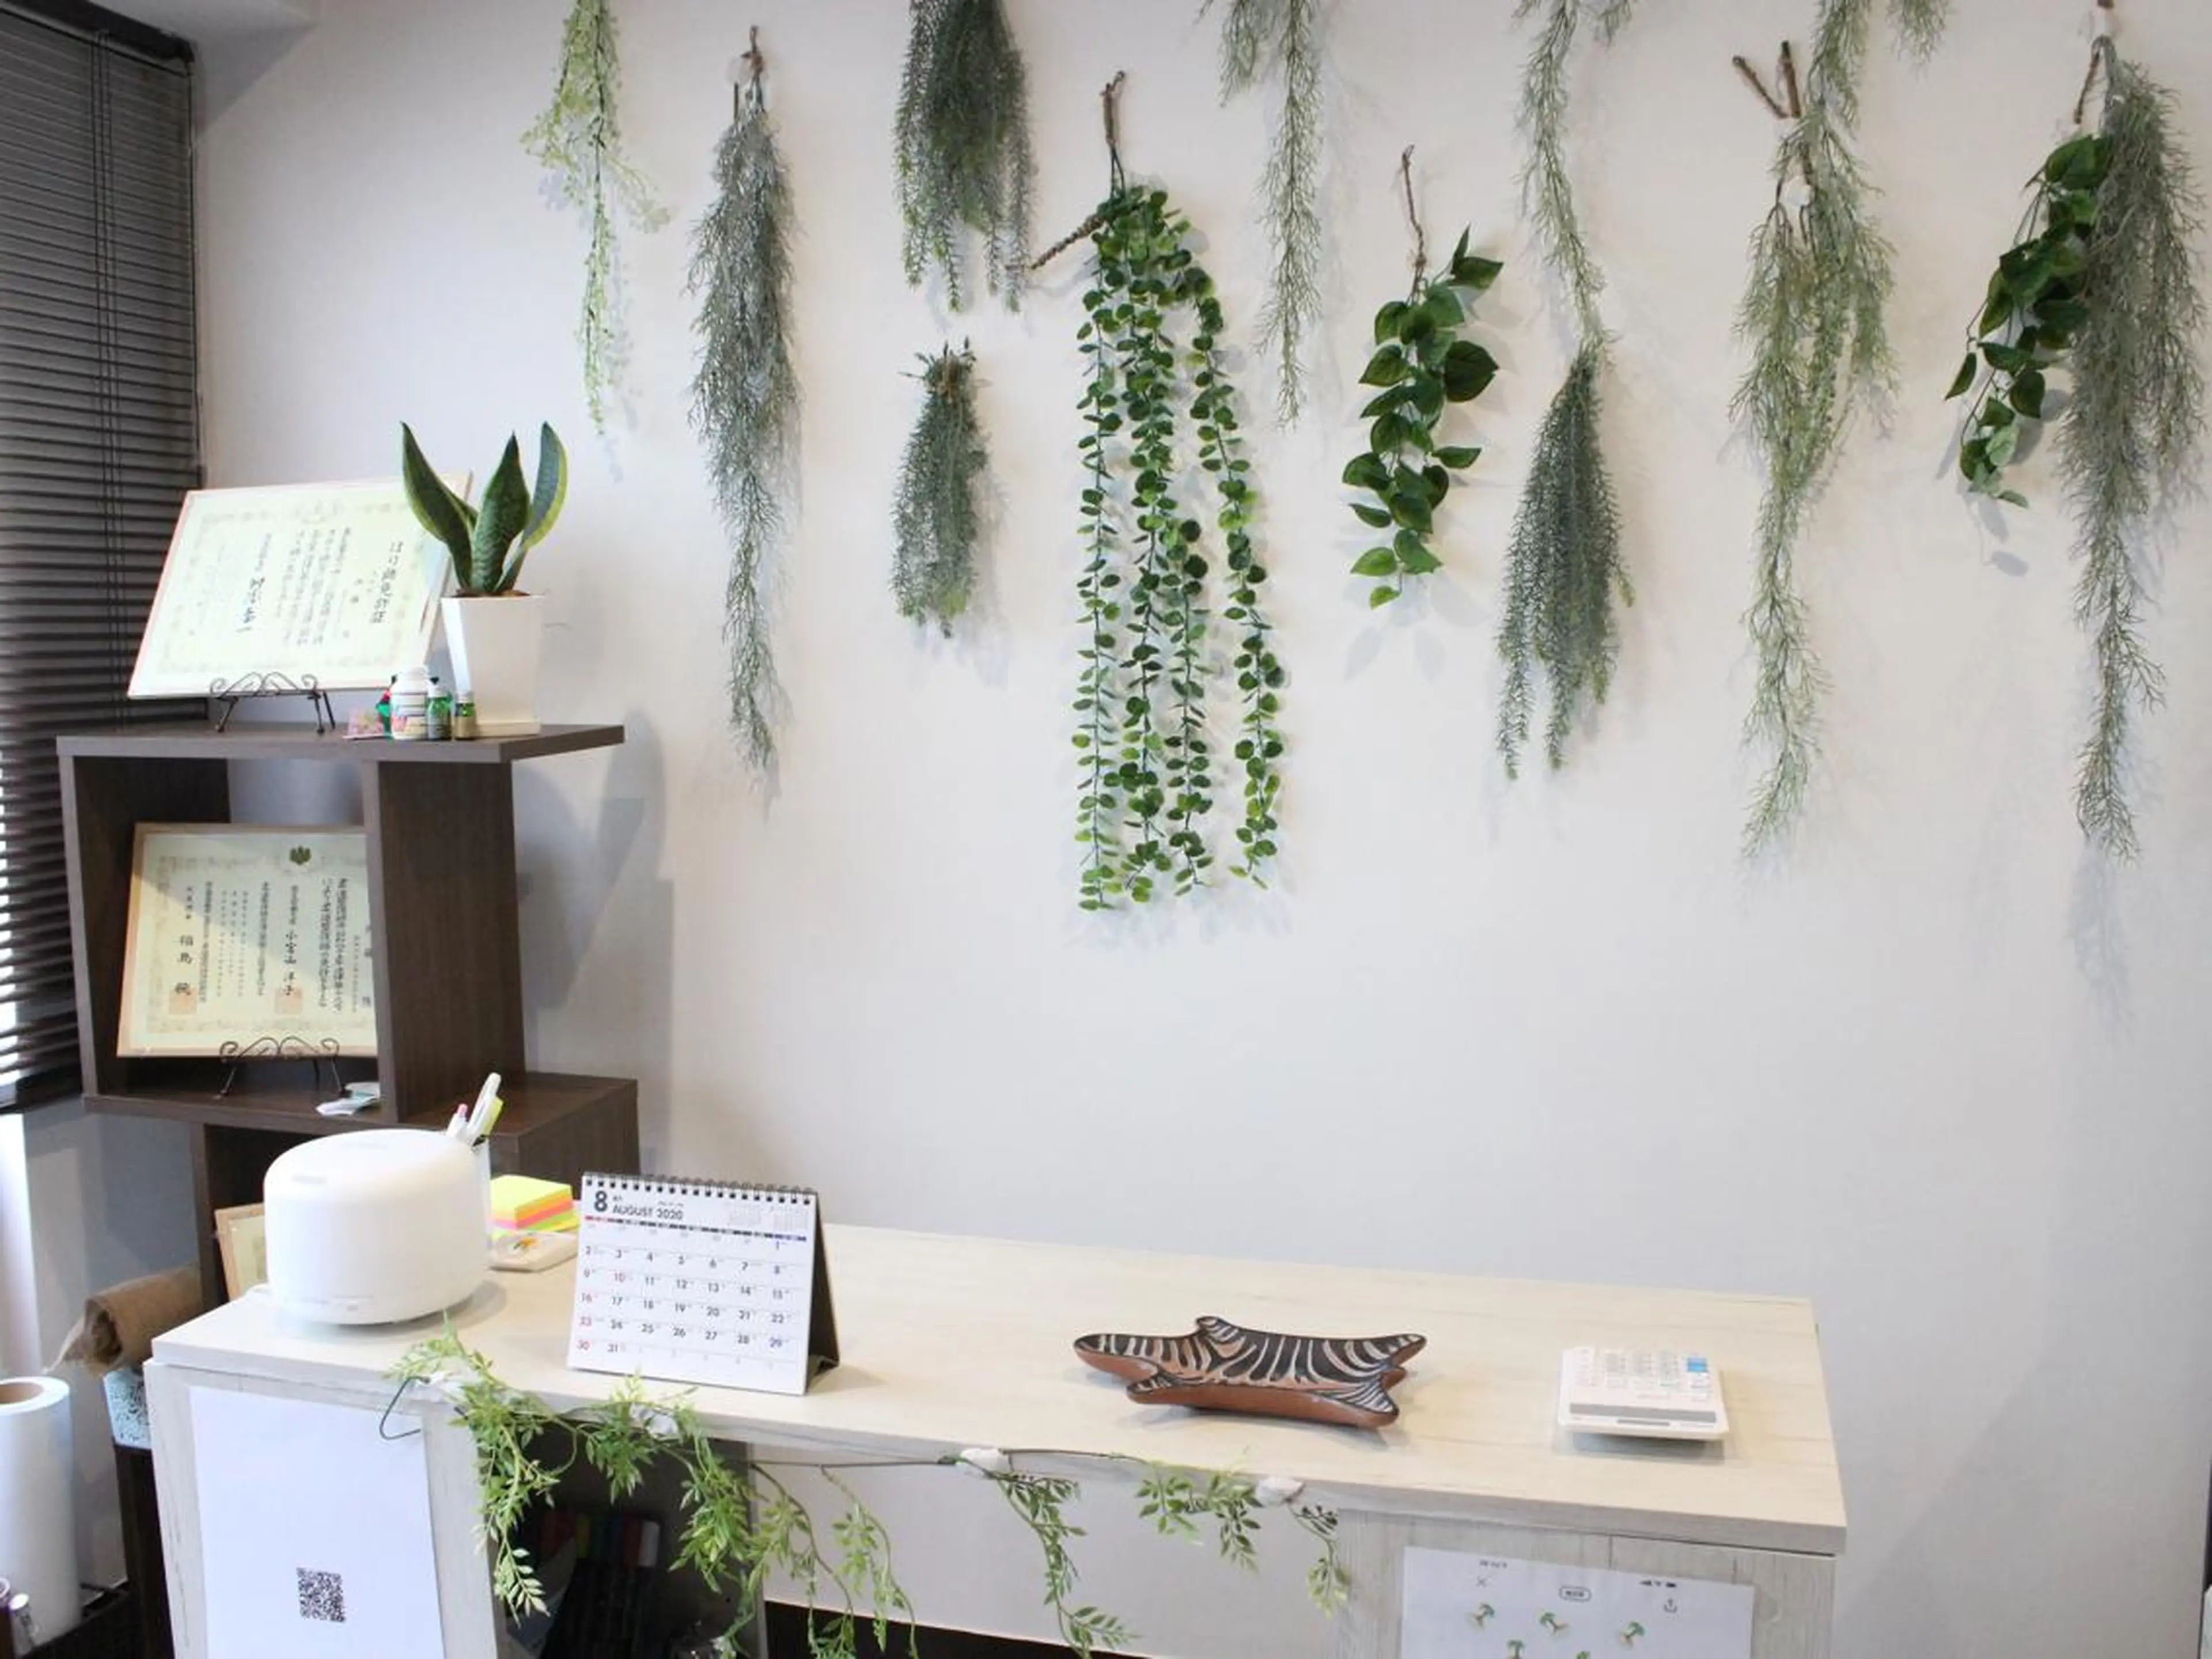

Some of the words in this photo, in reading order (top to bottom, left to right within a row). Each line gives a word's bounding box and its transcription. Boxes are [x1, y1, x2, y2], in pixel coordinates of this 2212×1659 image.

[594, 1190, 608, 1212] 8
[612, 1204, 653, 1217] AUGUST
[656, 1207, 684, 1219] 2020
[646, 1252, 653, 1262] 4
[614, 1272, 626, 1282] 10
[645, 1277, 655, 1286] 11
[676, 1279, 688, 1289] 12
[708, 1282, 719, 1293] 13
[741, 1285, 751, 1296] 14
[612, 1296, 623, 1306] 17
[643, 1300, 654, 1309] 18
[675, 1302, 686, 1312] 19
[706, 1306, 719, 1317] 20
[738, 1309, 751, 1320] 21
[771, 1313, 784, 1324] 22
[641, 1323, 654, 1334] 25
[673, 1327, 686, 1338] 26
[705, 1331, 718, 1340] 27
[770, 1337, 782, 1348] 29
